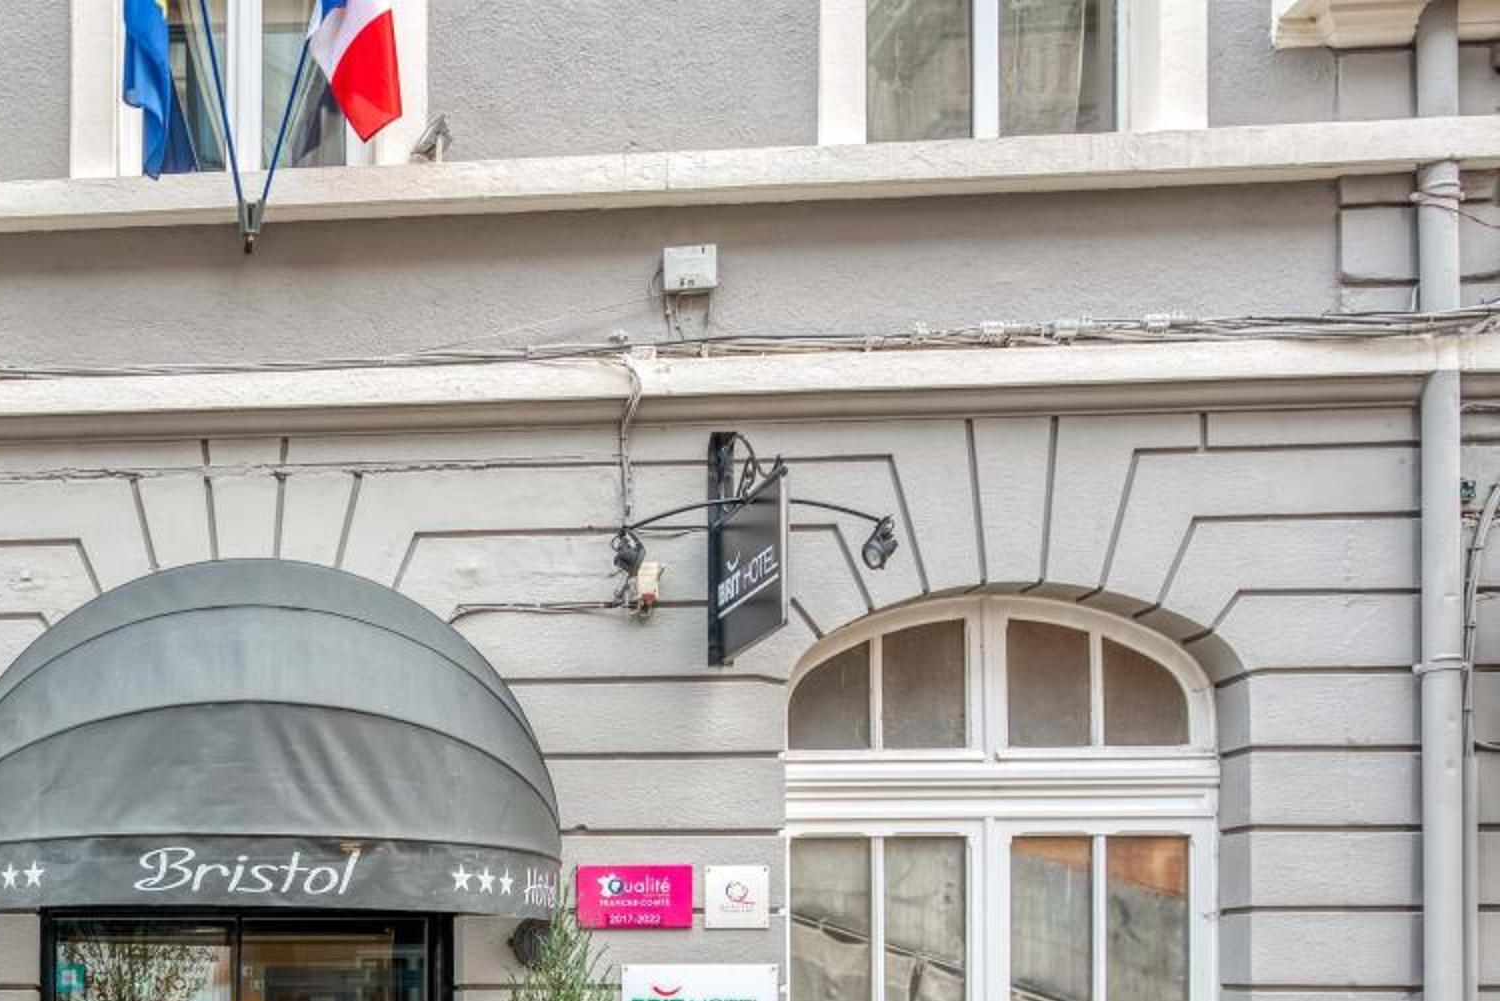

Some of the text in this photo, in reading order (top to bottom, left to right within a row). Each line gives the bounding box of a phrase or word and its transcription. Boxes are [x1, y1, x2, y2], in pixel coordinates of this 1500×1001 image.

[742, 545, 779, 590] HOTEL
[134, 846, 361, 895] Bristol
[607, 874, 670, 895] Qualité
